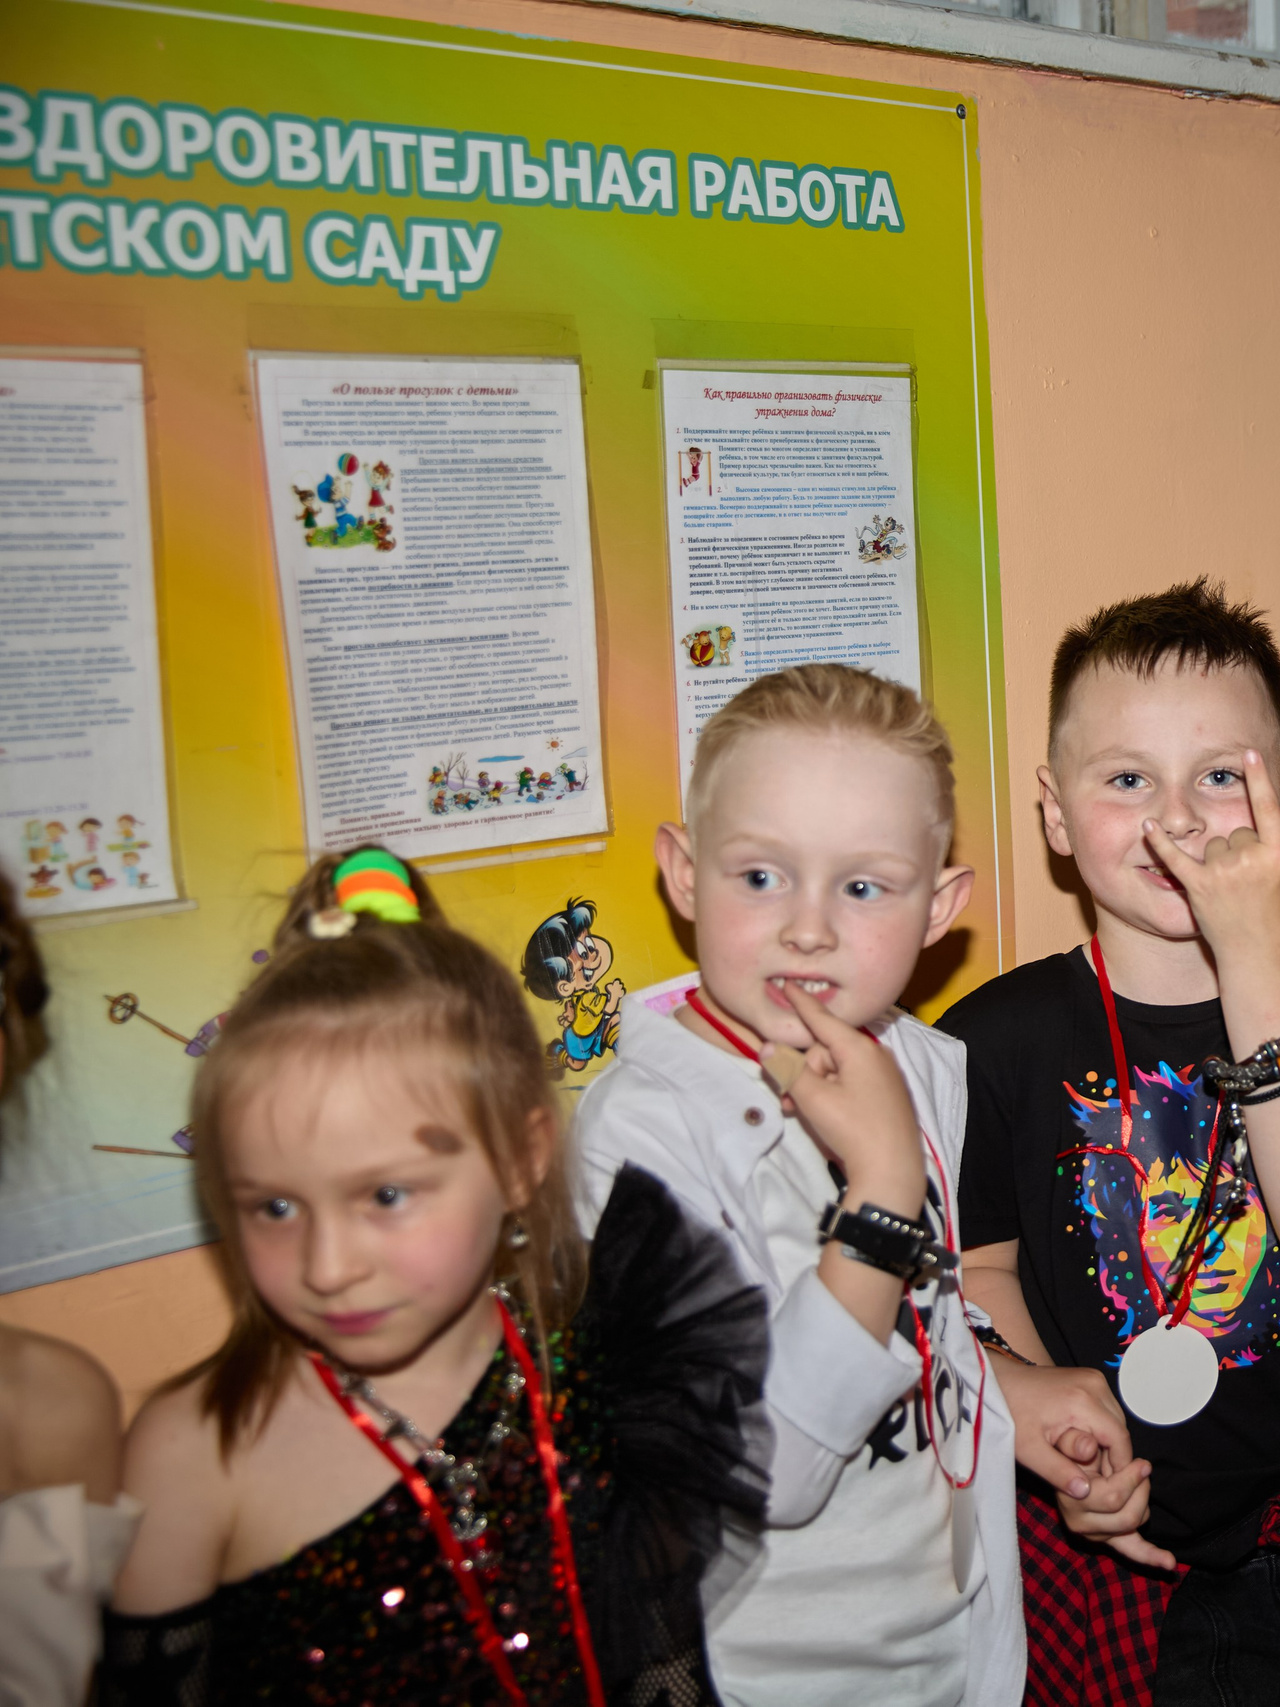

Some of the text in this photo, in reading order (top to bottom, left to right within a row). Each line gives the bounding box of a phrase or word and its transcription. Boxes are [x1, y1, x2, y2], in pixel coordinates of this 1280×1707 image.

[692, 158, 901, 228] РАБОТА
[308, 217, 497, 296] САДУ
[354, 386, 396, 396] пользе
[398, 386, 454, 398] прогулок
[457, 388, 464, 396] с
[466, 386, 519, 398] детьми»
[704, 388, 882, 404] Как правильно организовать физические
[754, 406, 836, 419] упражнения дома?
